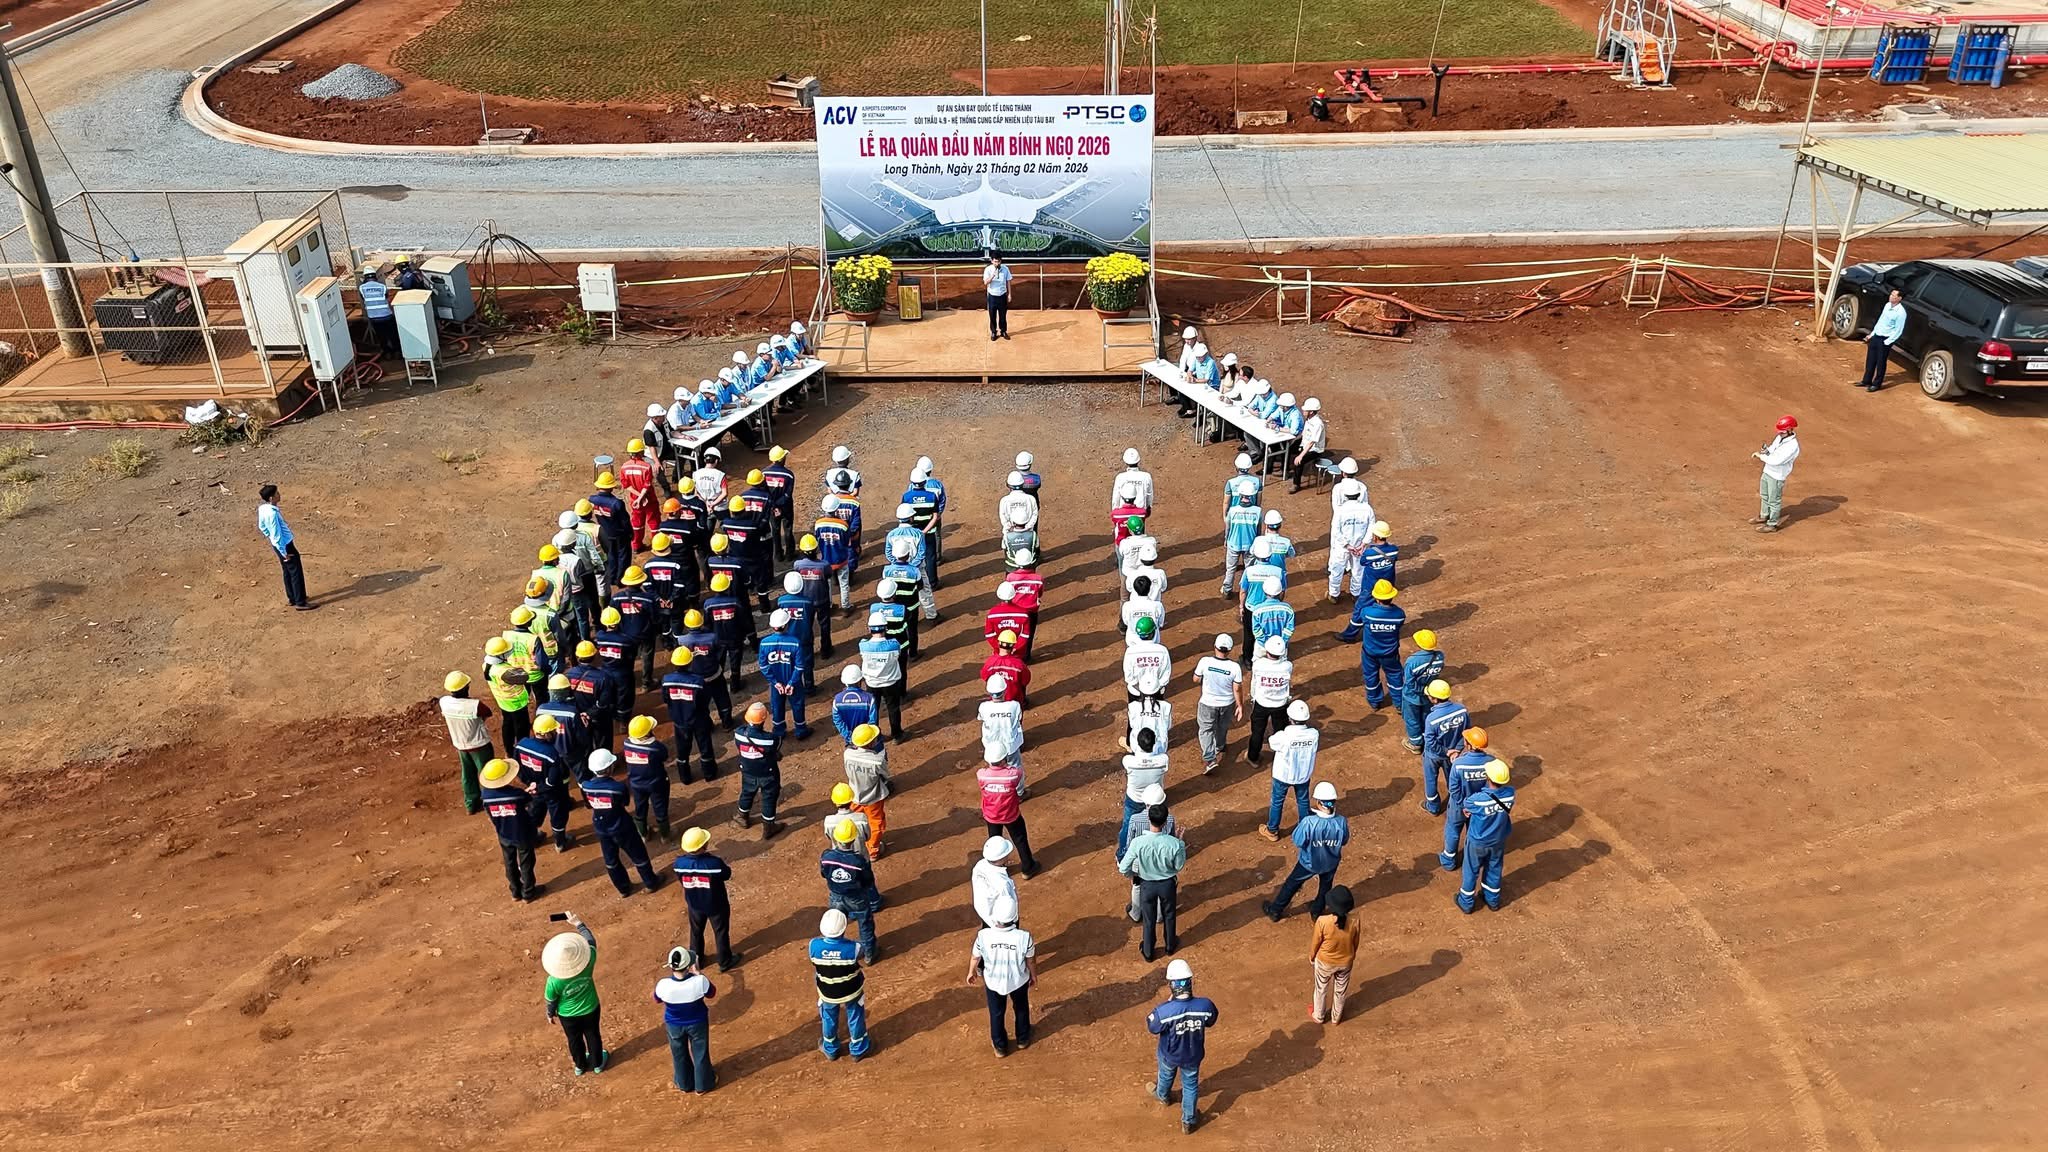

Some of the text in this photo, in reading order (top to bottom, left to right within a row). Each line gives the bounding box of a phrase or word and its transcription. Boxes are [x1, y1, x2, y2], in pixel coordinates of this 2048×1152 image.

[966, 104, 976, 112] BAY
[1000, 104, 1013, 112] LONG
[1063, 106, 1125, 119] PTSC
[823, 106, 858, 125] ACV
[860, 129, 1110, 160] LỄ RA QUÂN ĐẦU NĂM BÍNH NGỌ 2026
[884, 162, 1088, 177] Long Thành, Ngày 23 Tháng 02 Năm 2026
[1261, 676, 1284, 684] PTSC
[1464, 771, 1487, 779] LTEC
[991, 943, 1017, 951] PTSC
